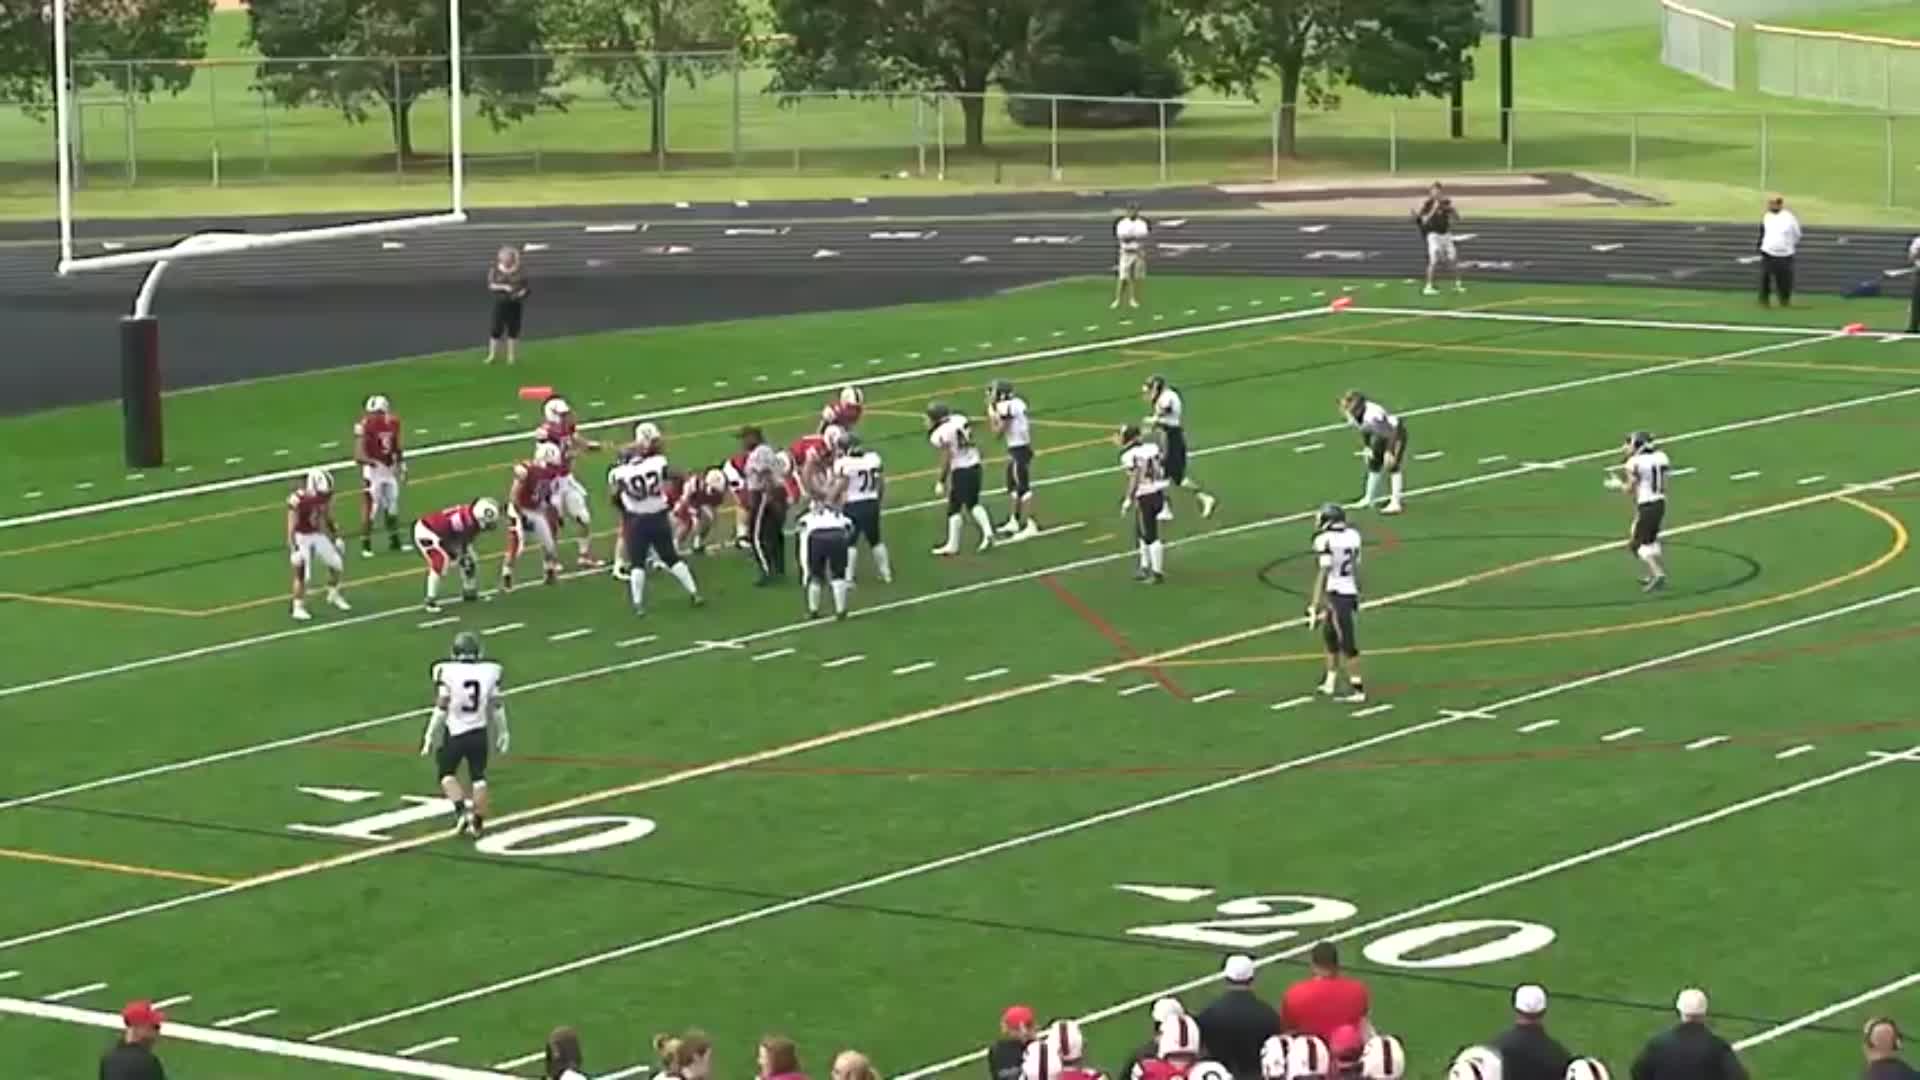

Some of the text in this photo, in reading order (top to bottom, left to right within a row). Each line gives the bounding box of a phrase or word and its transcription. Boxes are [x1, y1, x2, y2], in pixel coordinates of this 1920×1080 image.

[630, 470, 661, 499] 92
[463, 680, 480, 713] 3
[1125, 895, 1556, 968] 20
